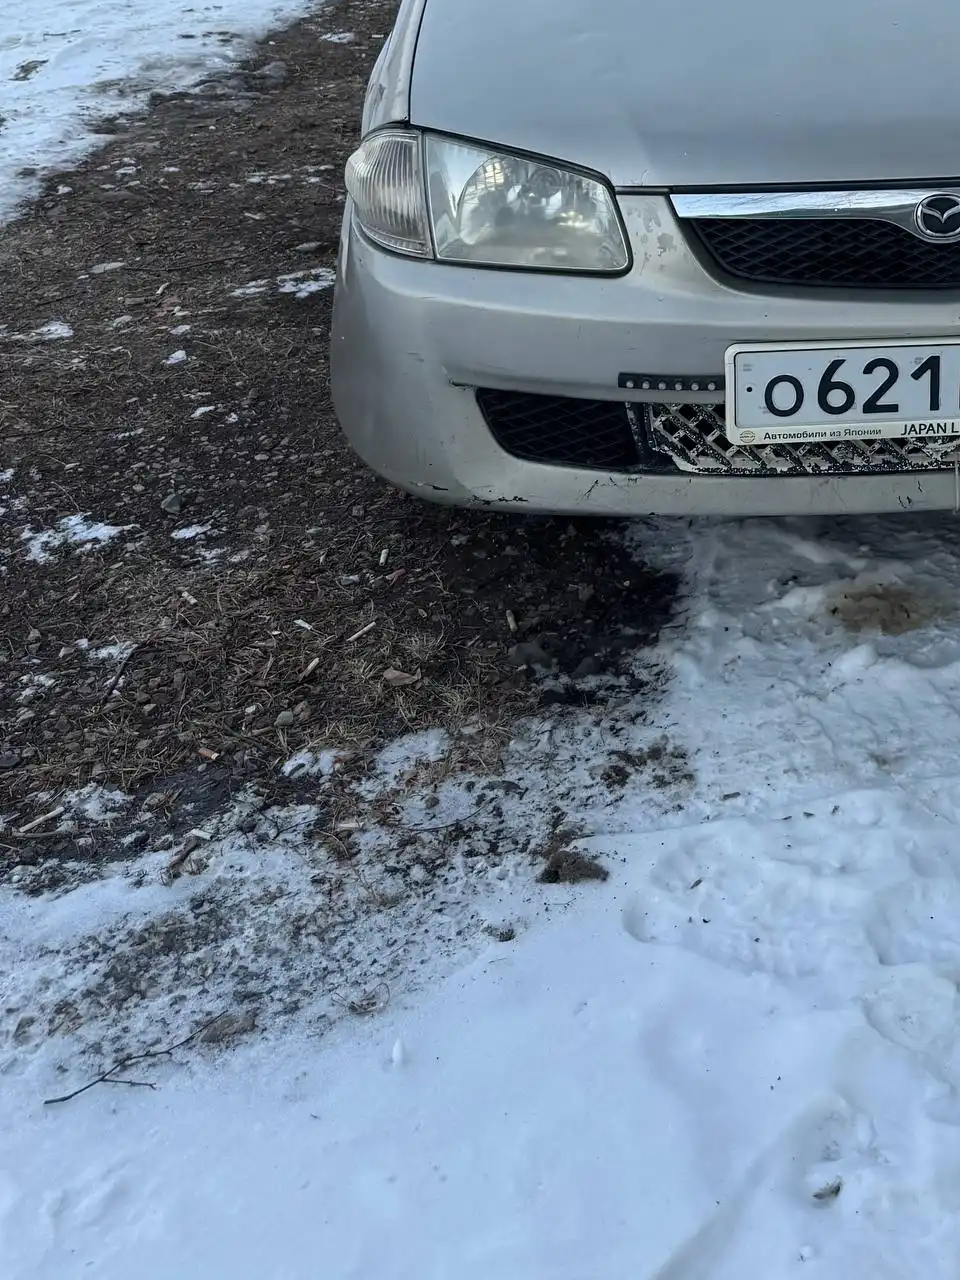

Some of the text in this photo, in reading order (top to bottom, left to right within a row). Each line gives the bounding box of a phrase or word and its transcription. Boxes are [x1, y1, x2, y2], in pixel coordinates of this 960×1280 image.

[763, 429, 827, 441] Автомобили
[829, 430, 842, 438] из
[844, 428, 882, 437] Японии
[900, 423, 947, 436] JAPAN
